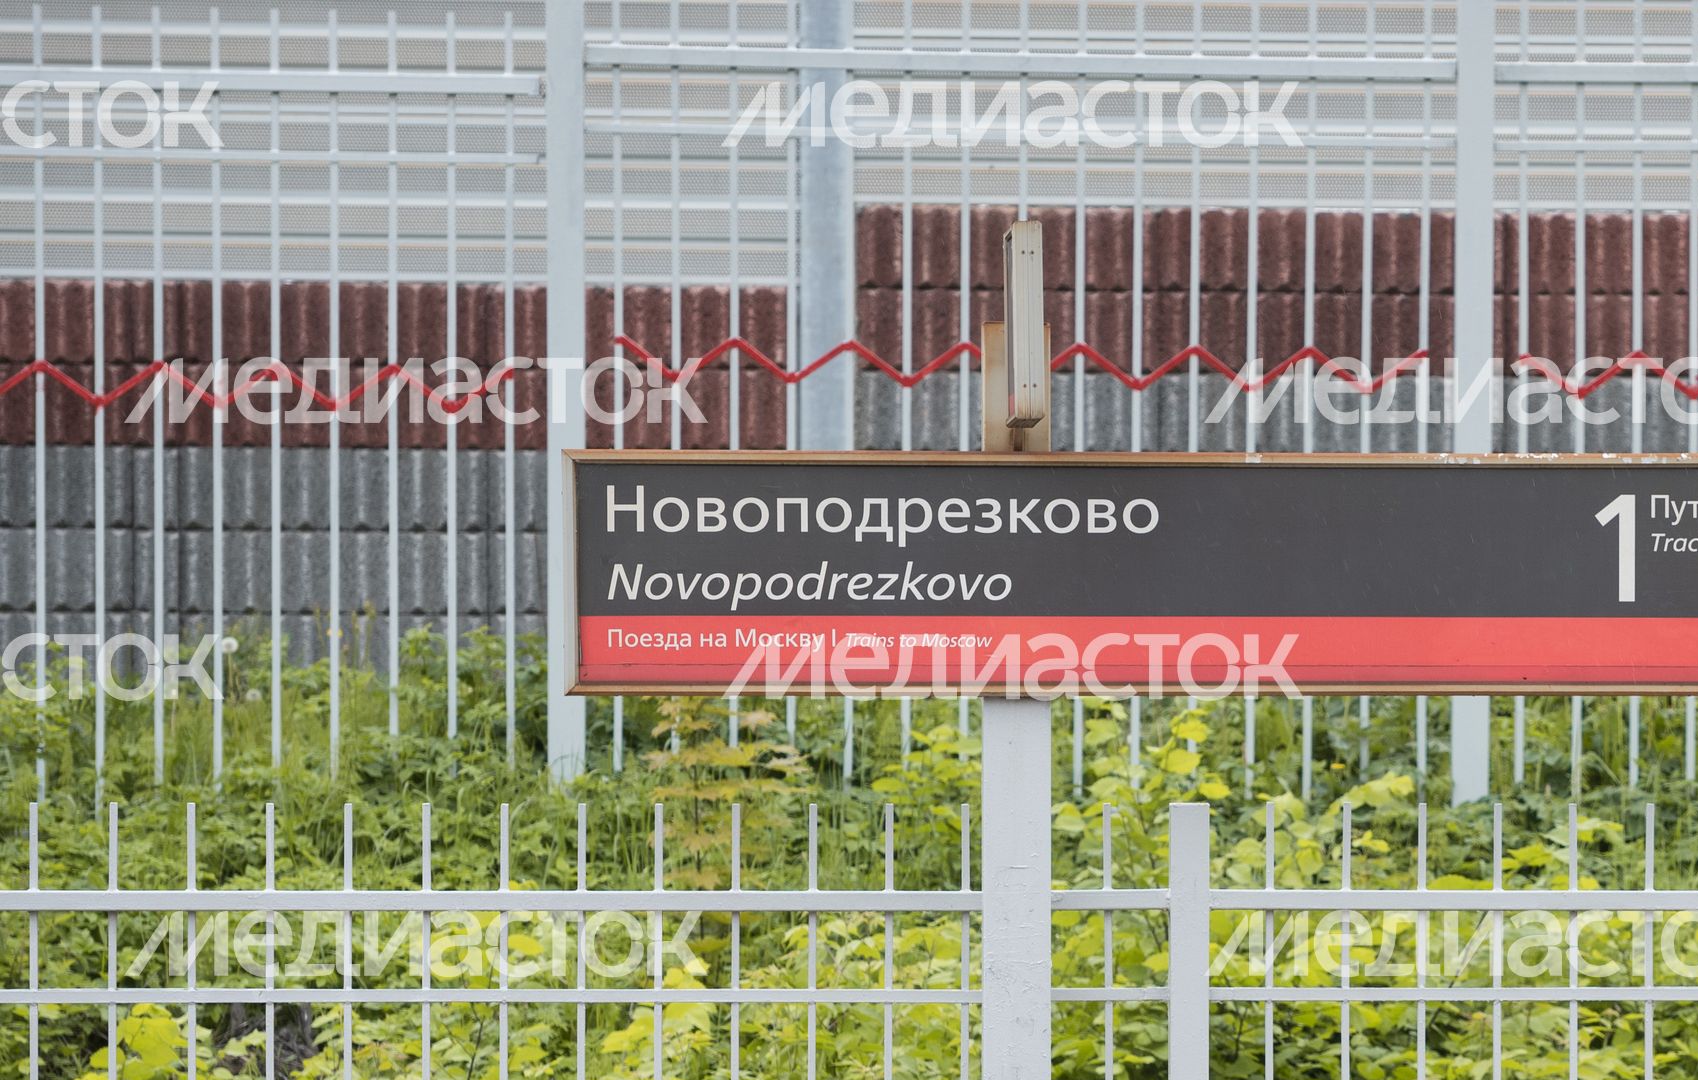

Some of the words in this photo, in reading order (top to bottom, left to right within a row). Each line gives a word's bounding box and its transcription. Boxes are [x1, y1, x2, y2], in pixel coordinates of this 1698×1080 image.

[607, 485, 1160, 547] Новоподрезково
[1595, 495, 1635, 602] 1
[608, 561, 1012, 611] Novopodrezkovo
[607, 629, 692, 650] Поезда
[701, 633, 727, 648] на
[736, 629, 826, 653] Москву
[846, 632, 895, 649] Trains
[900, 634, 917, 648] to
[921, 633, 993, 649] Moscow
